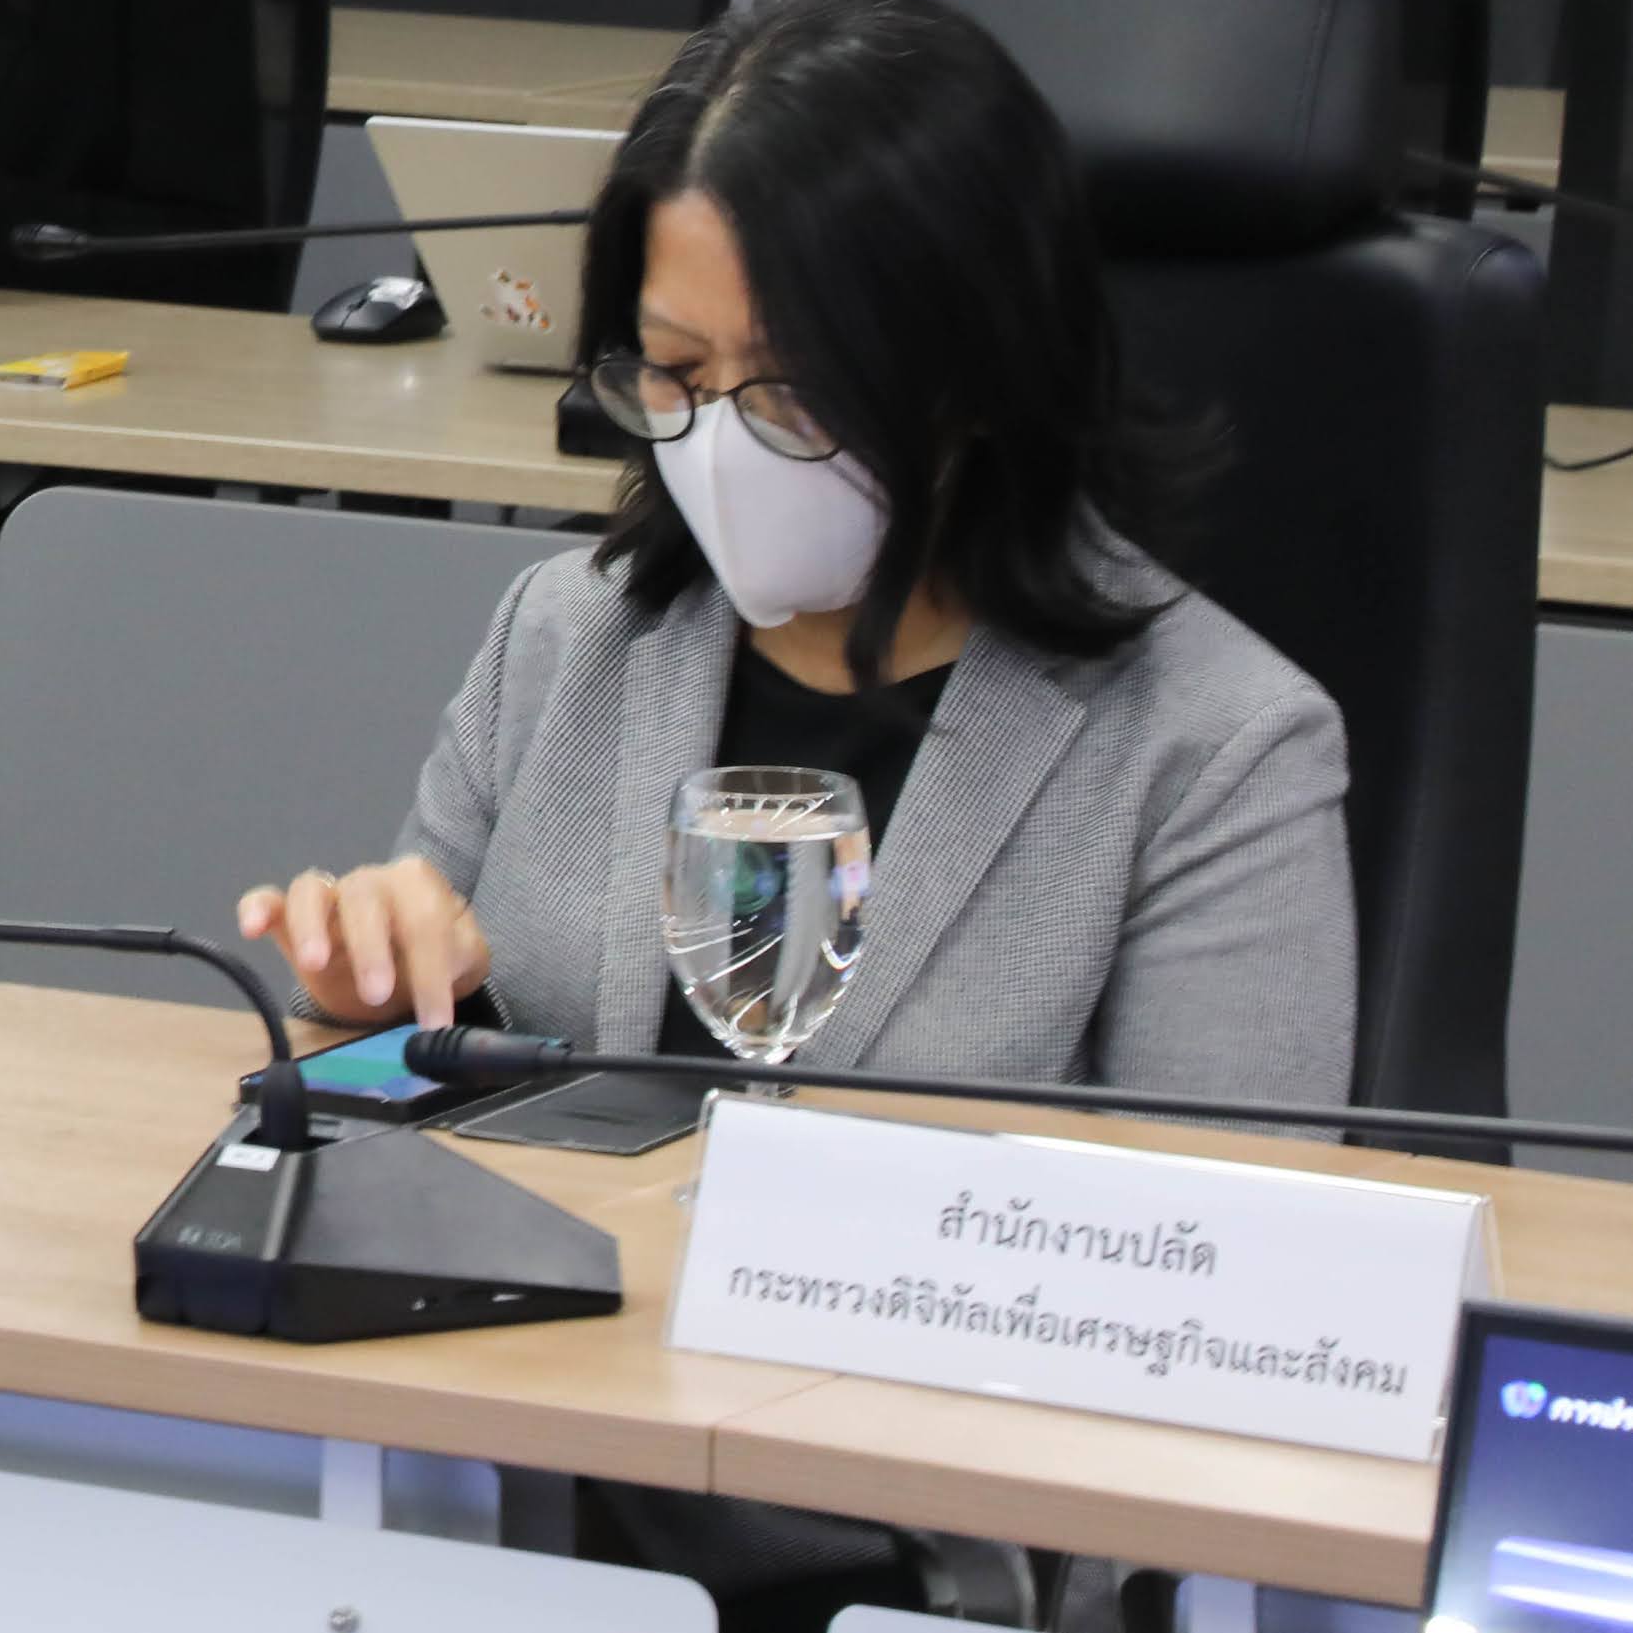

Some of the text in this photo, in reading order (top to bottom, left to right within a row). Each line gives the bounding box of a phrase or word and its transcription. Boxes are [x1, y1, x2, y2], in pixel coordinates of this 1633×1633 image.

[937, 1190, 1219, 1277] สำนักงานปลัด
[727, 1263, 1408, 1395] กระทรวงดิจิทัลเพื่อเศรษฐกิจและสังคม
